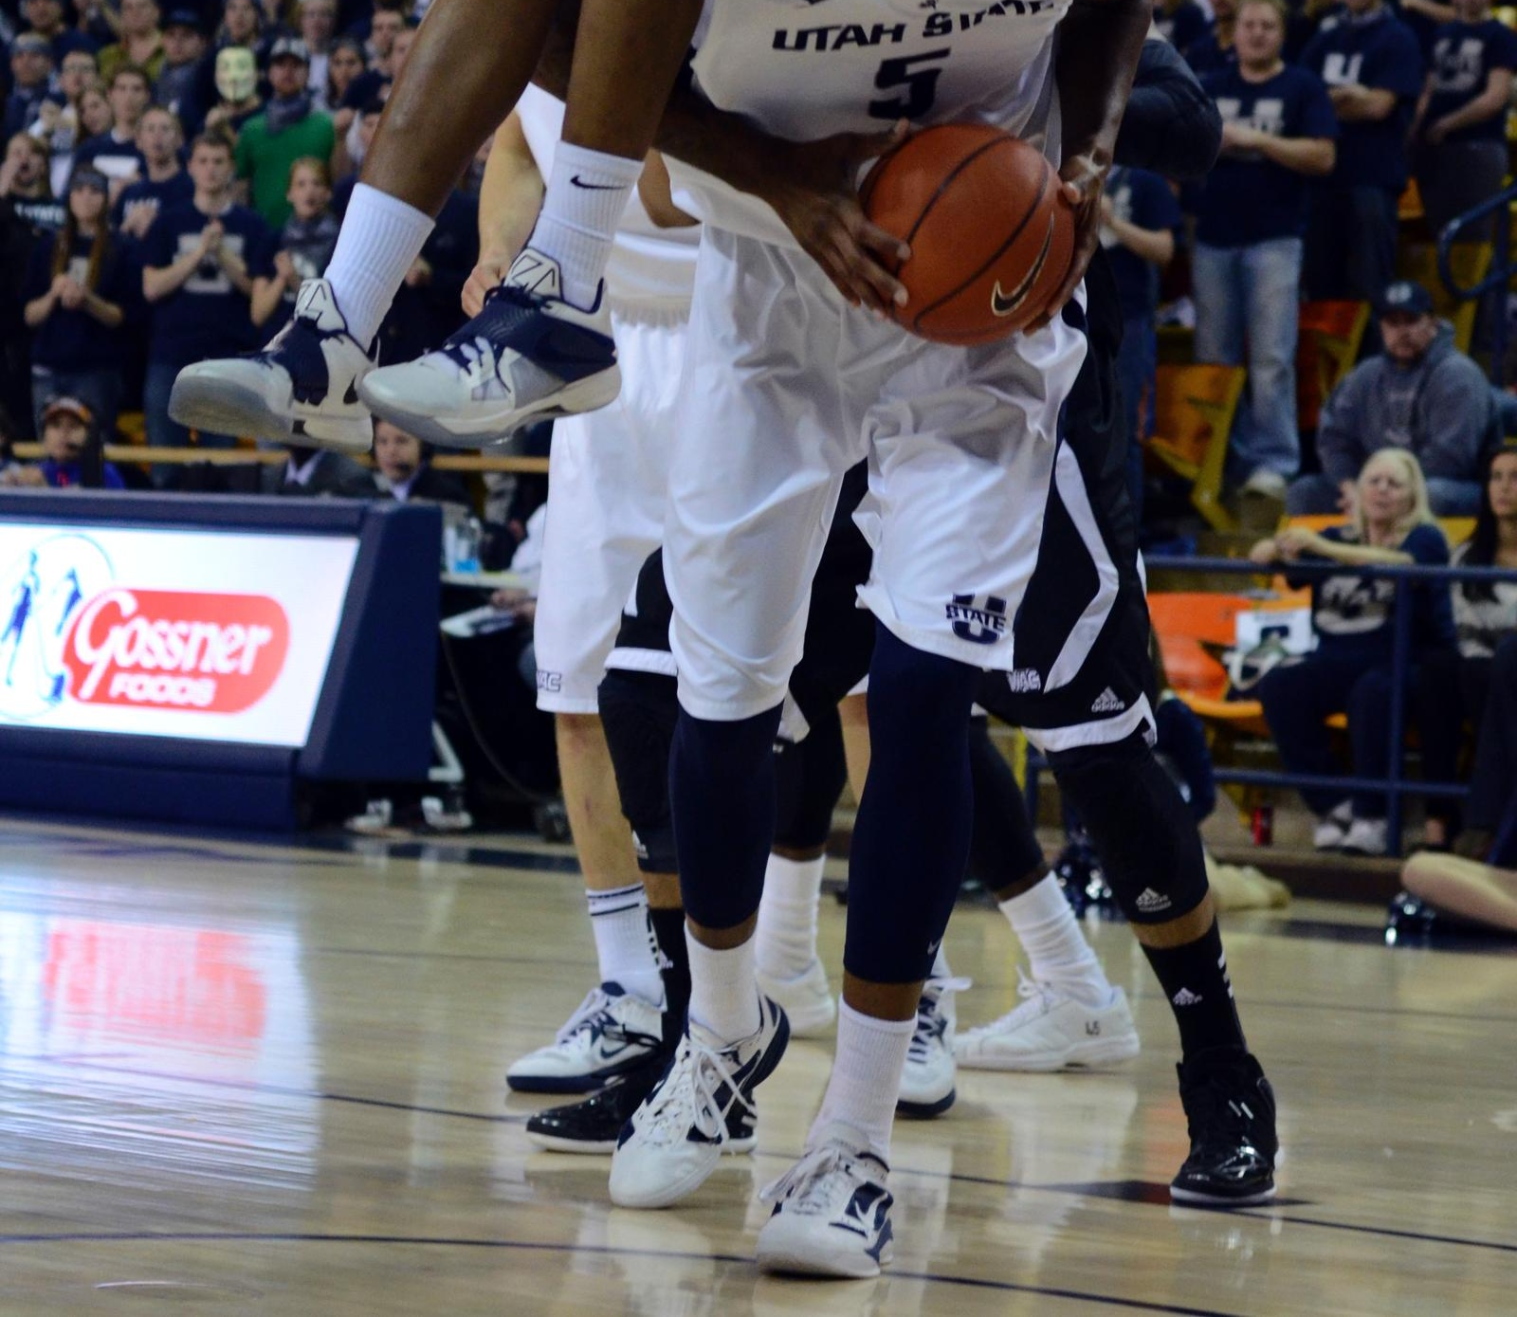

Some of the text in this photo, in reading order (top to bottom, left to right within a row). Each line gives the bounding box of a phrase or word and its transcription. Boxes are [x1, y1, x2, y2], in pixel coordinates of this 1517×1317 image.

[772, 23, 906, 52] UTAH
[868, 47, 951, 119] 5
[945, 603, 1007, 633] STATE
[74, 588, 272, 700] Gossner
[537, 669, 562, 693] AC
